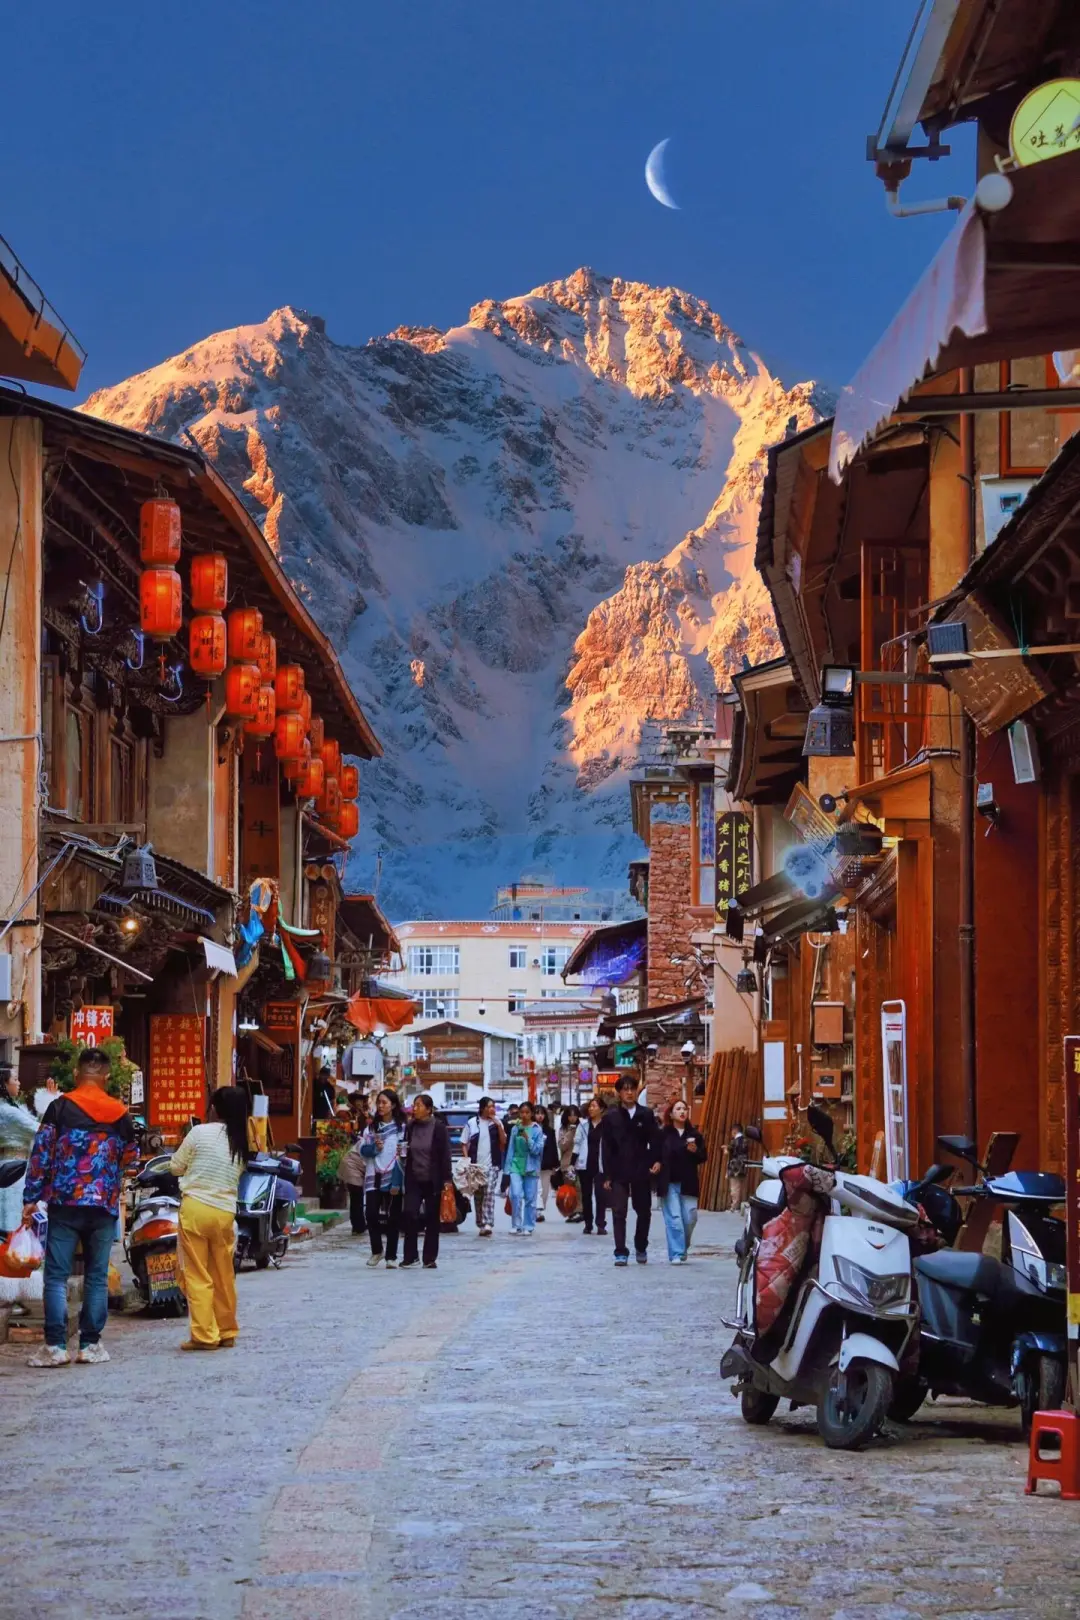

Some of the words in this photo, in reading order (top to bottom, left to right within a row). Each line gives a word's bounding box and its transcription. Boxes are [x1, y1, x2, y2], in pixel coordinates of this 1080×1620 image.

[74, 1009, 111, 1028] 冲锋衣
[179, 1079, 202, 1089] 土豆片
